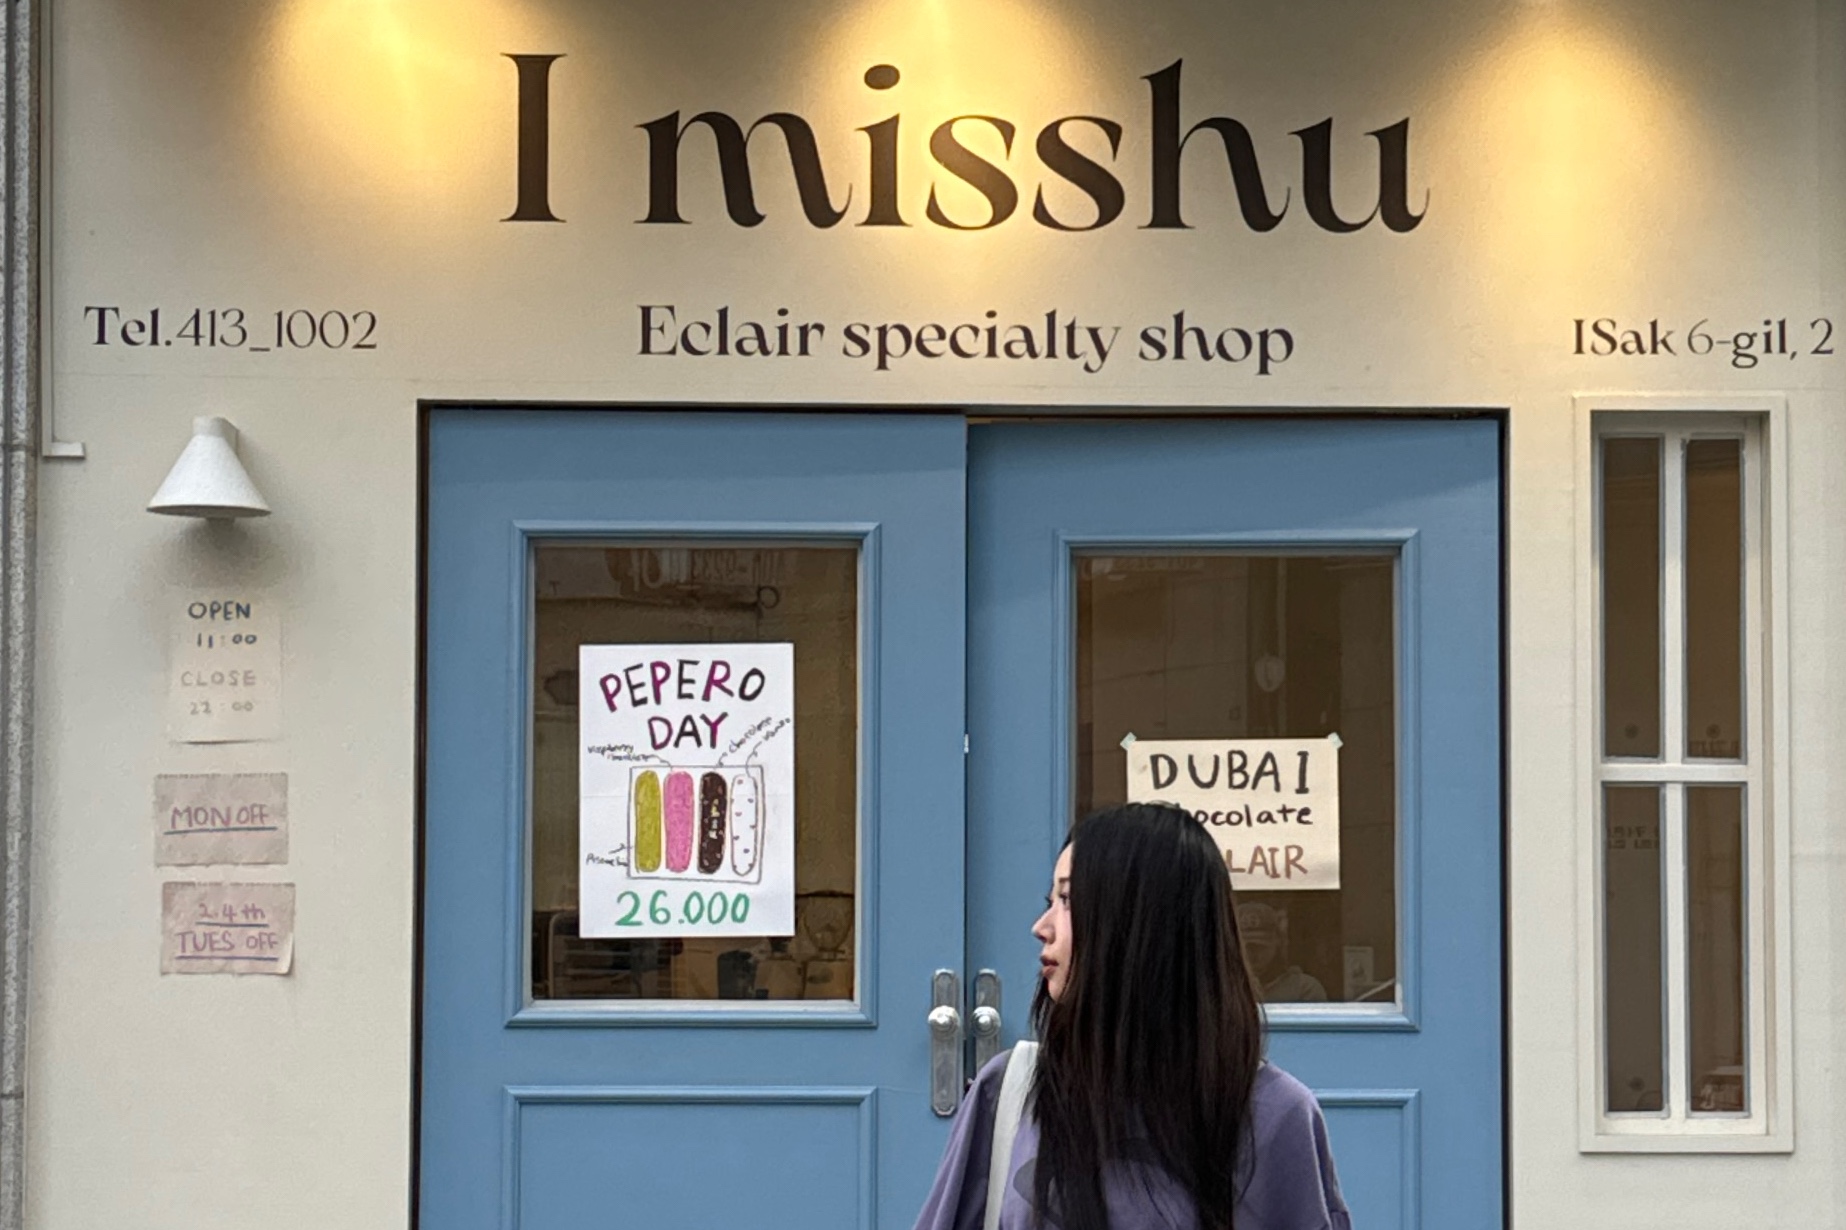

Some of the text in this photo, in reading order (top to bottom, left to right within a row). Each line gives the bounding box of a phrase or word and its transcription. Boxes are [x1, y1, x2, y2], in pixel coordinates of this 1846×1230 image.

[501, 53, 1430, 234] I misshu
[84, 305, 378, 353] Tel.413_1002
[638, 304, 1295, 376] Eclair specialty shop
[1573, 318, 1835, 370] ISak 6-gil, 2
[188, 601, 251, 621] OPEN
[181, 670, 257, 687] CLOSE
[600, 659, 765, 712] PEPERO
[647, 711, 729, 752] DAY
[1149, 749, 1311, 796] DUBAI
[171, 803, 269, 829] MON OFF
[1193, 803, 1314, 828] ocolate
[1225, 844, 1309, 880] LAIR
[614, 890, 751, 927] 26.000
[176, 931, 279, 953] TUES OFF
